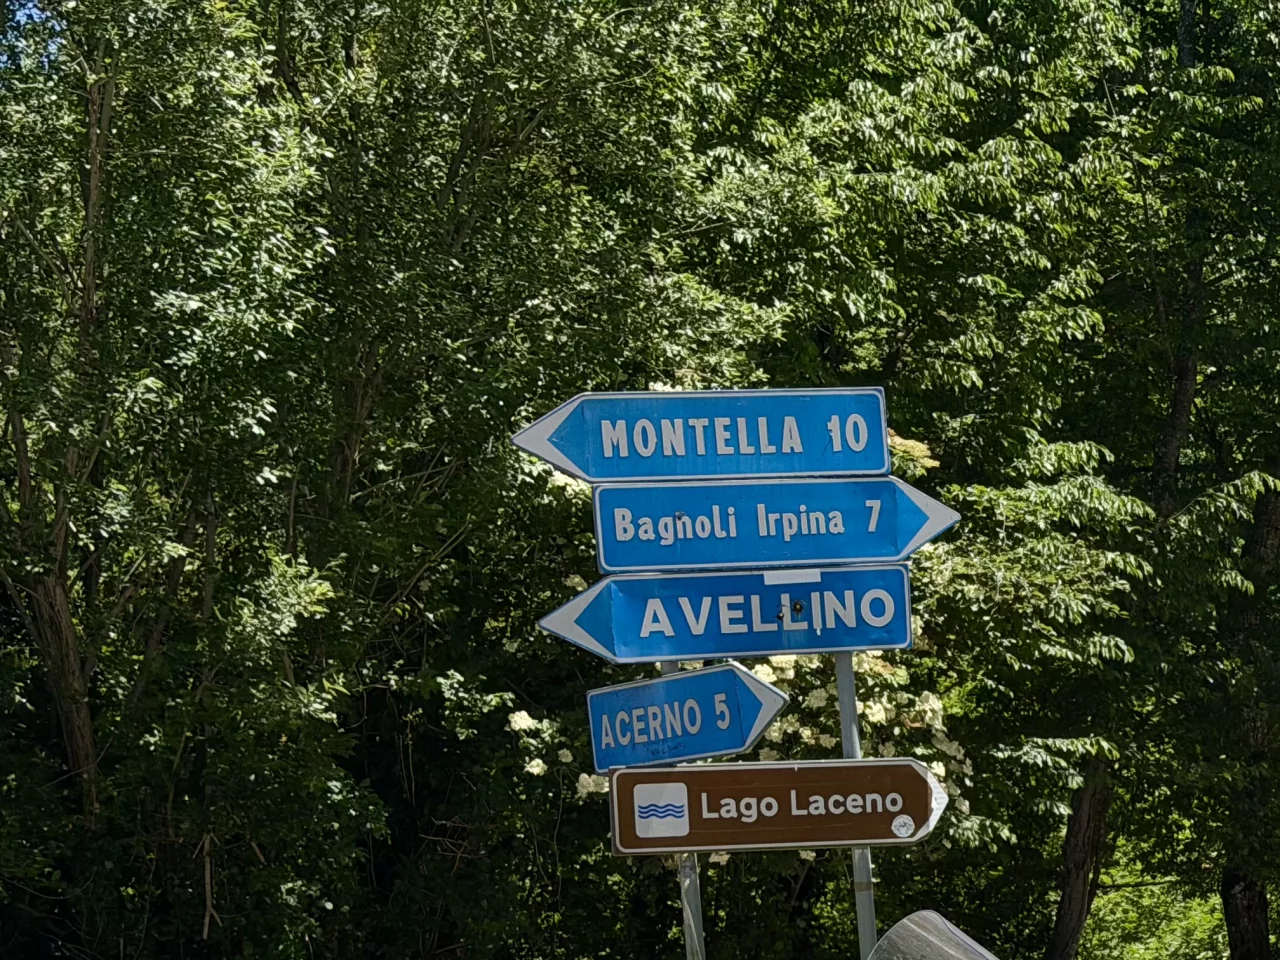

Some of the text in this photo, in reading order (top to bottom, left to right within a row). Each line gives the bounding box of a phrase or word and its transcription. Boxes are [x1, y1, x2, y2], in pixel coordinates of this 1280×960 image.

[600, 413, 868, 458] MONTELLA 10
[613, 499, 882, 546] Bagnoli Irpina 7
[639, 588, 896, 638] AVELLINO
[601, 692, 731, 750] ACERNO 5
[701, 789, 904, 824] Lago Laceno
